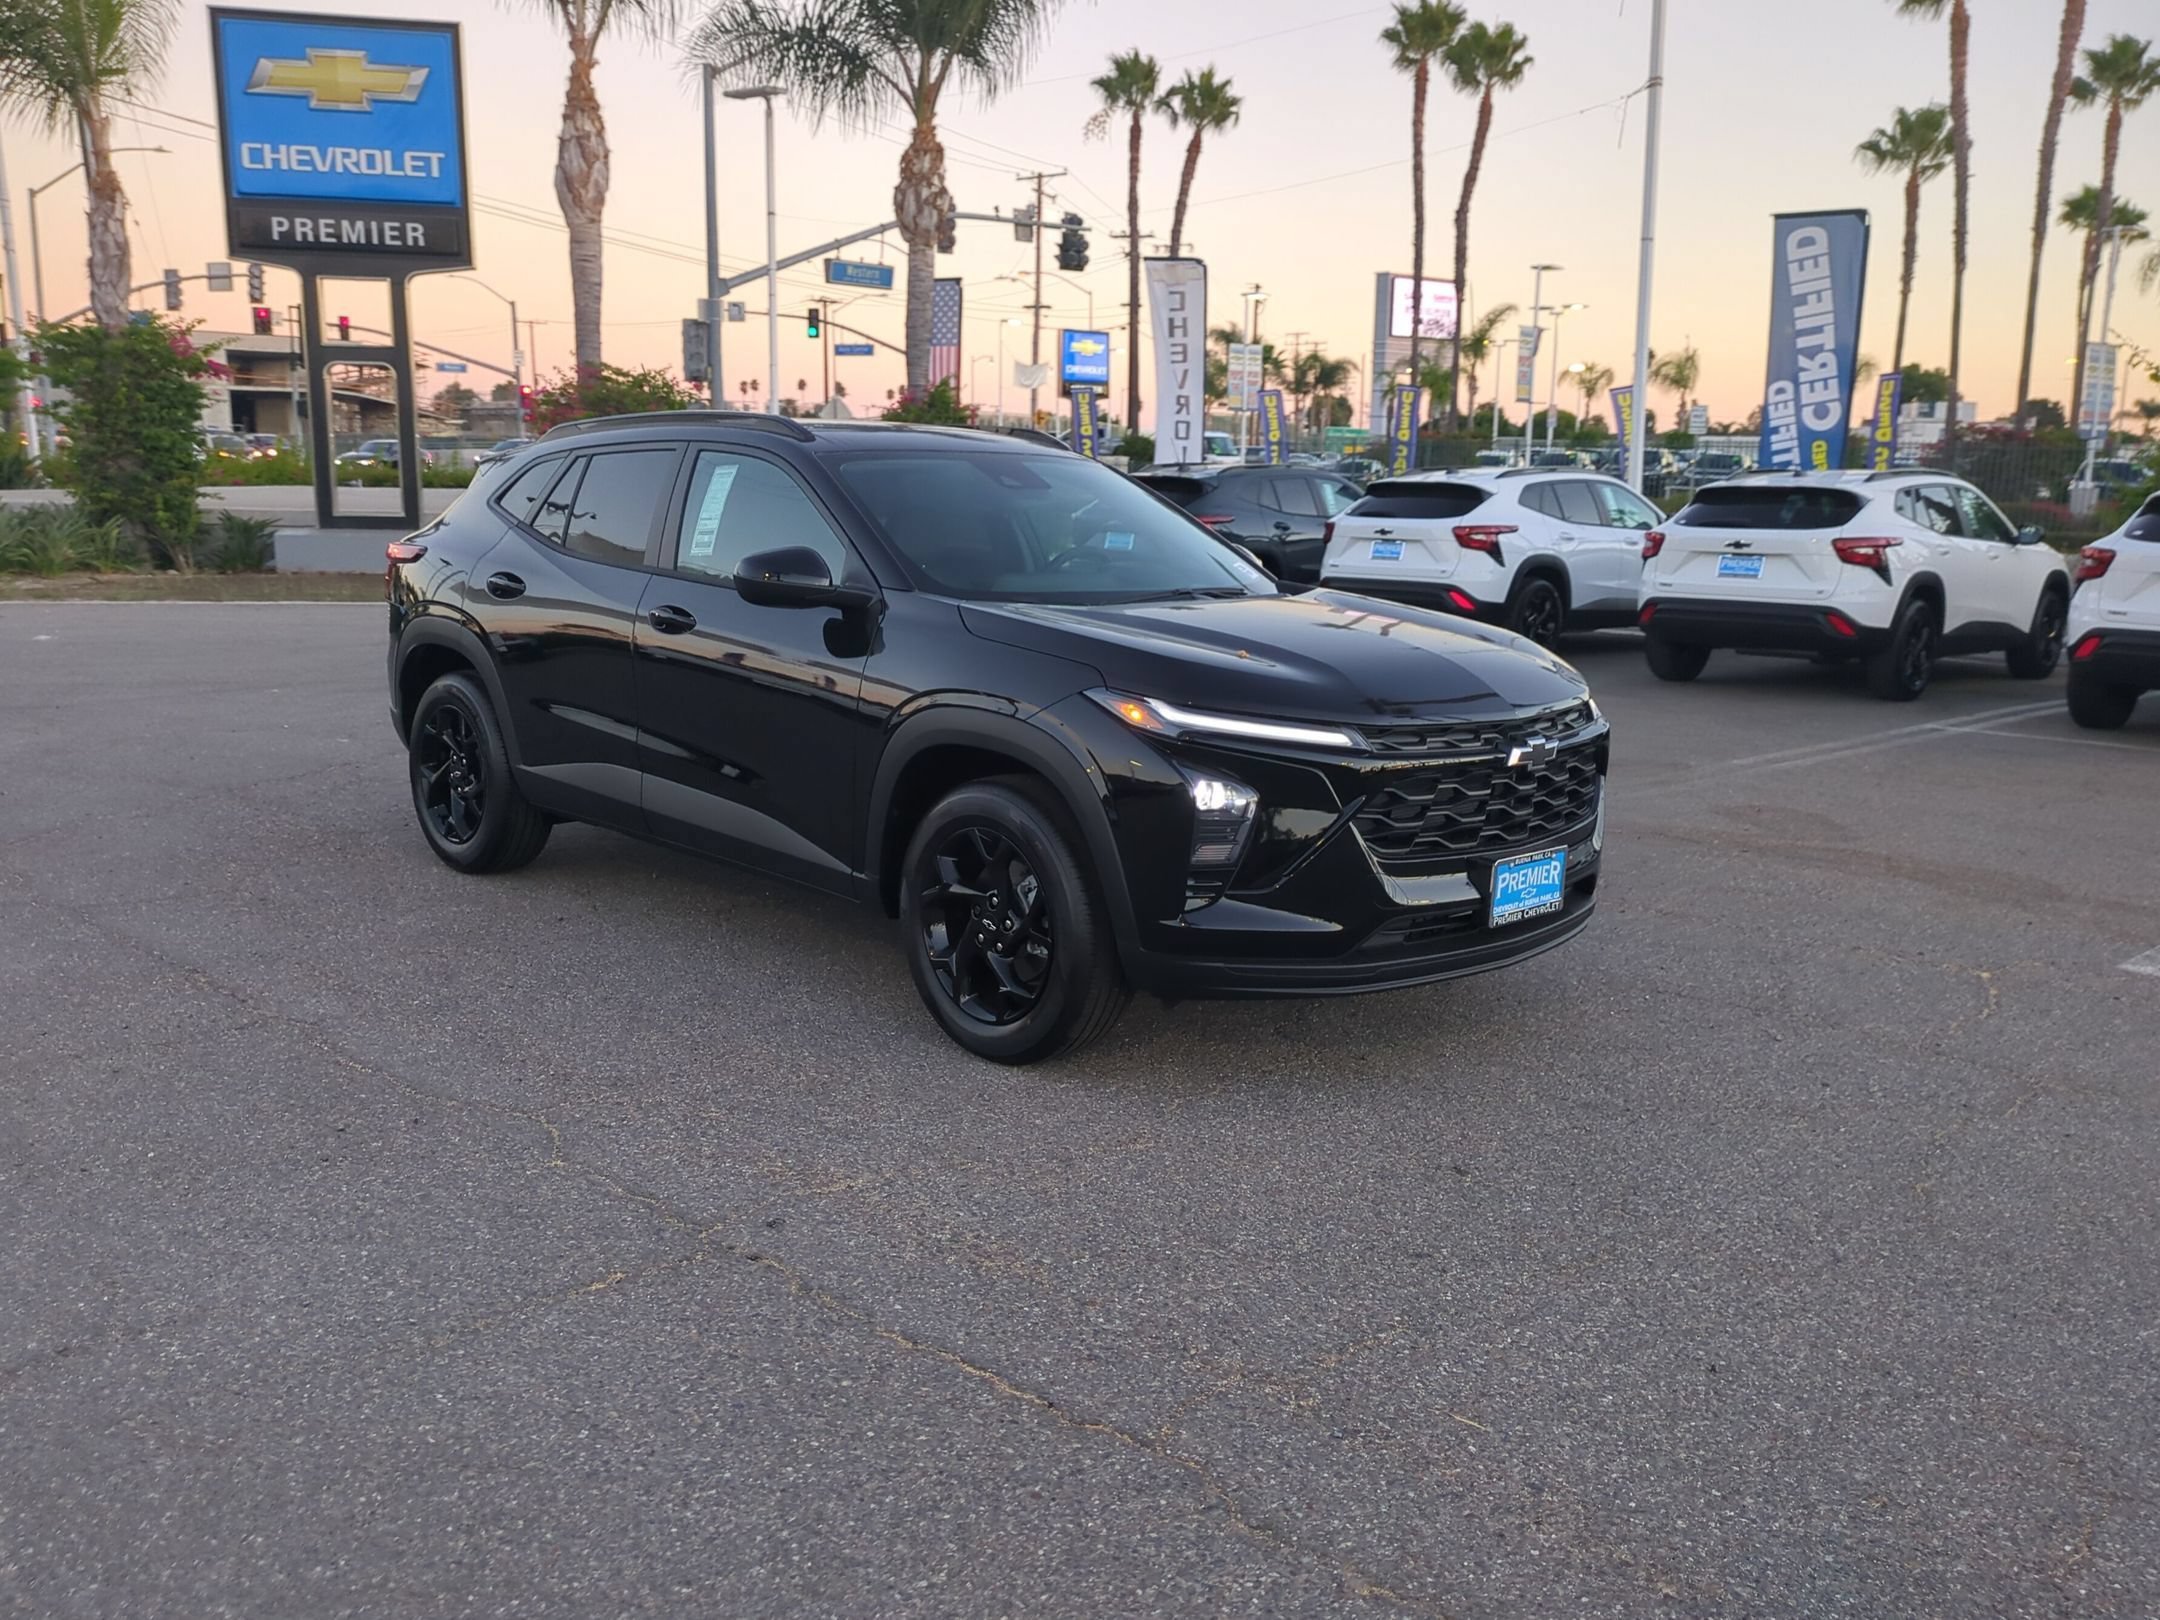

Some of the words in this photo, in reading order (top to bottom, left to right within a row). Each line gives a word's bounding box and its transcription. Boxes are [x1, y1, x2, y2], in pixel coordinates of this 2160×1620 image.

[241, 142, 446, 178] CHEVROLET
[271, 216, 426, 247] PREMIER
[846, 265, 880, 279] Western
[1496, 861, 1560, 899] PREMIER
[1493, 911, 1522, 927] PREMIER
[1524, 902, 1559, 918] CHEVROLET
